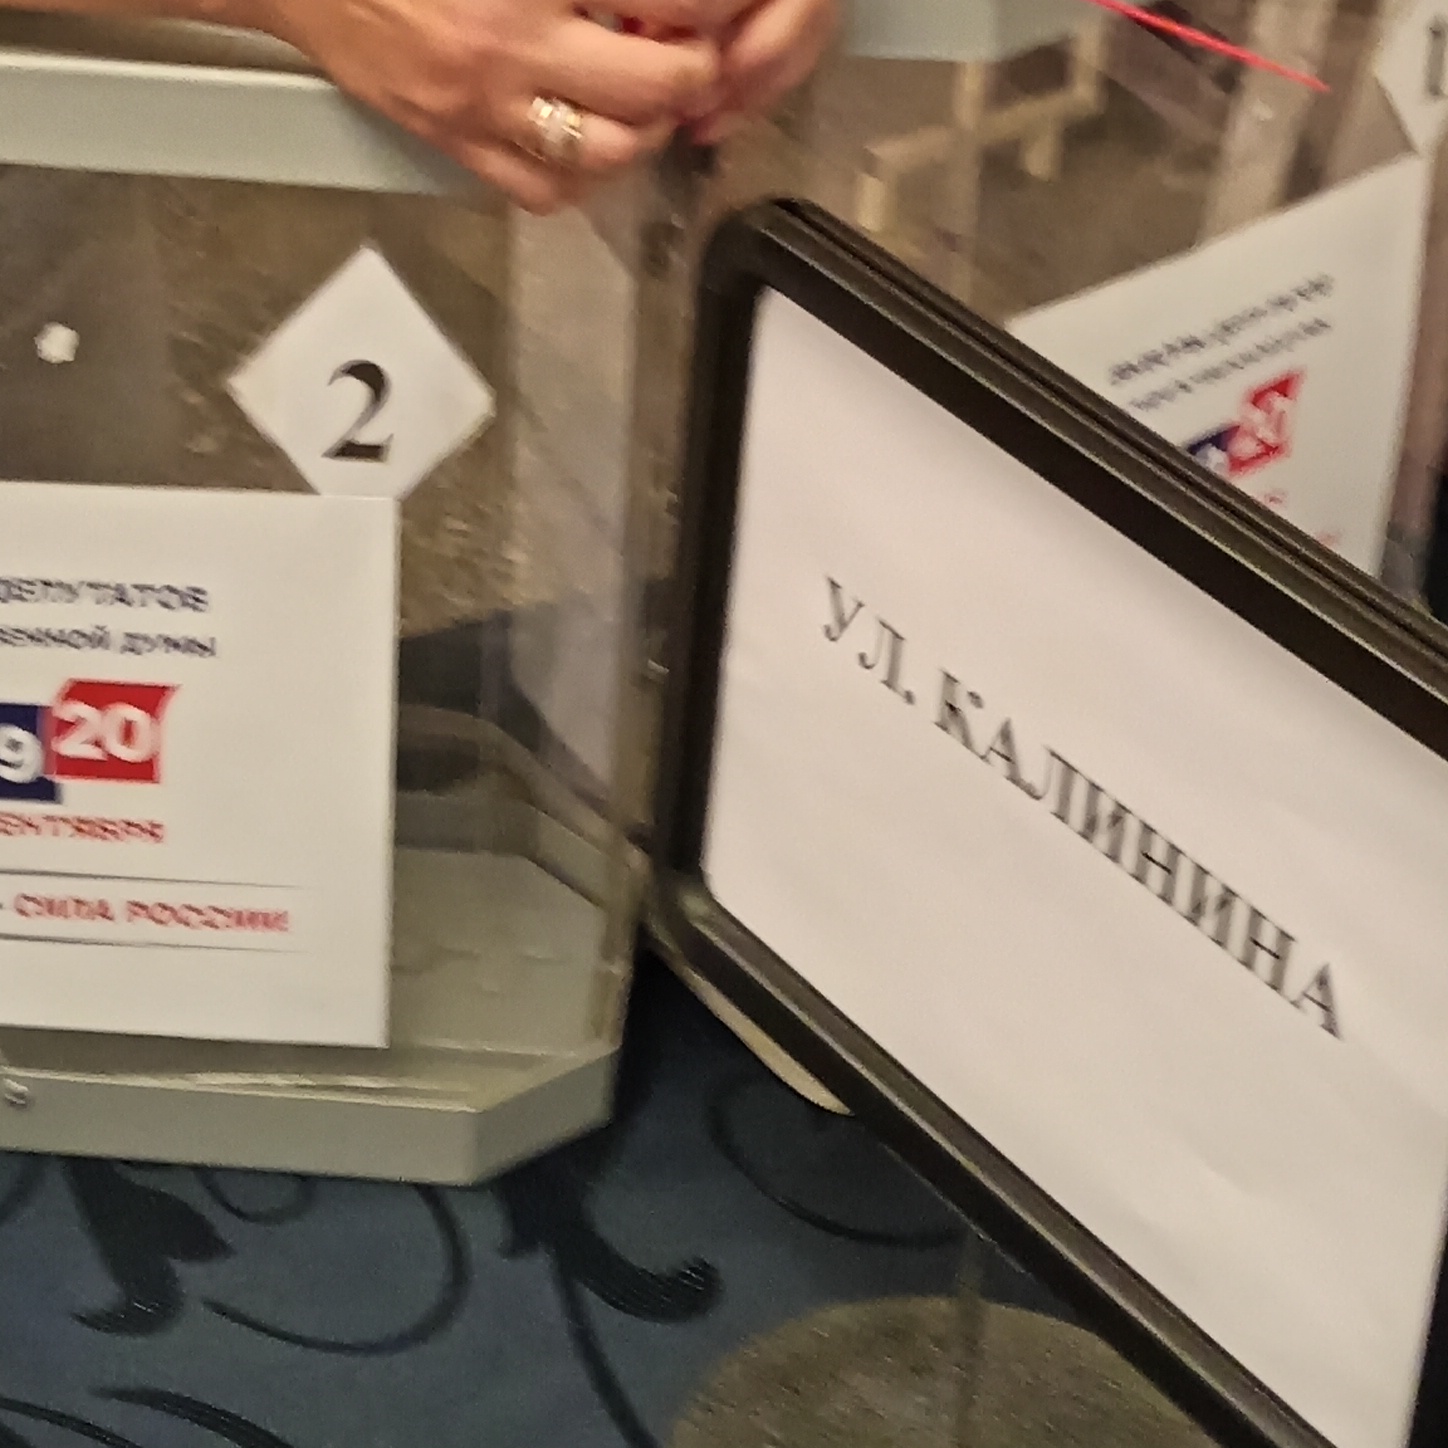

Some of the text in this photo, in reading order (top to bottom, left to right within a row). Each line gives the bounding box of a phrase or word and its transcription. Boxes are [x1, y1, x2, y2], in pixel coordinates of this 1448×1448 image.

[322, 359, 397, 463] 2
[119, 629, 217, 658] ДУМЫ
[52, 700, 161, 763] 20
[822, 574, 1344, 1041] УЛ. КАЛИНИНА
[14, 890, 115, 923] СИЛА
